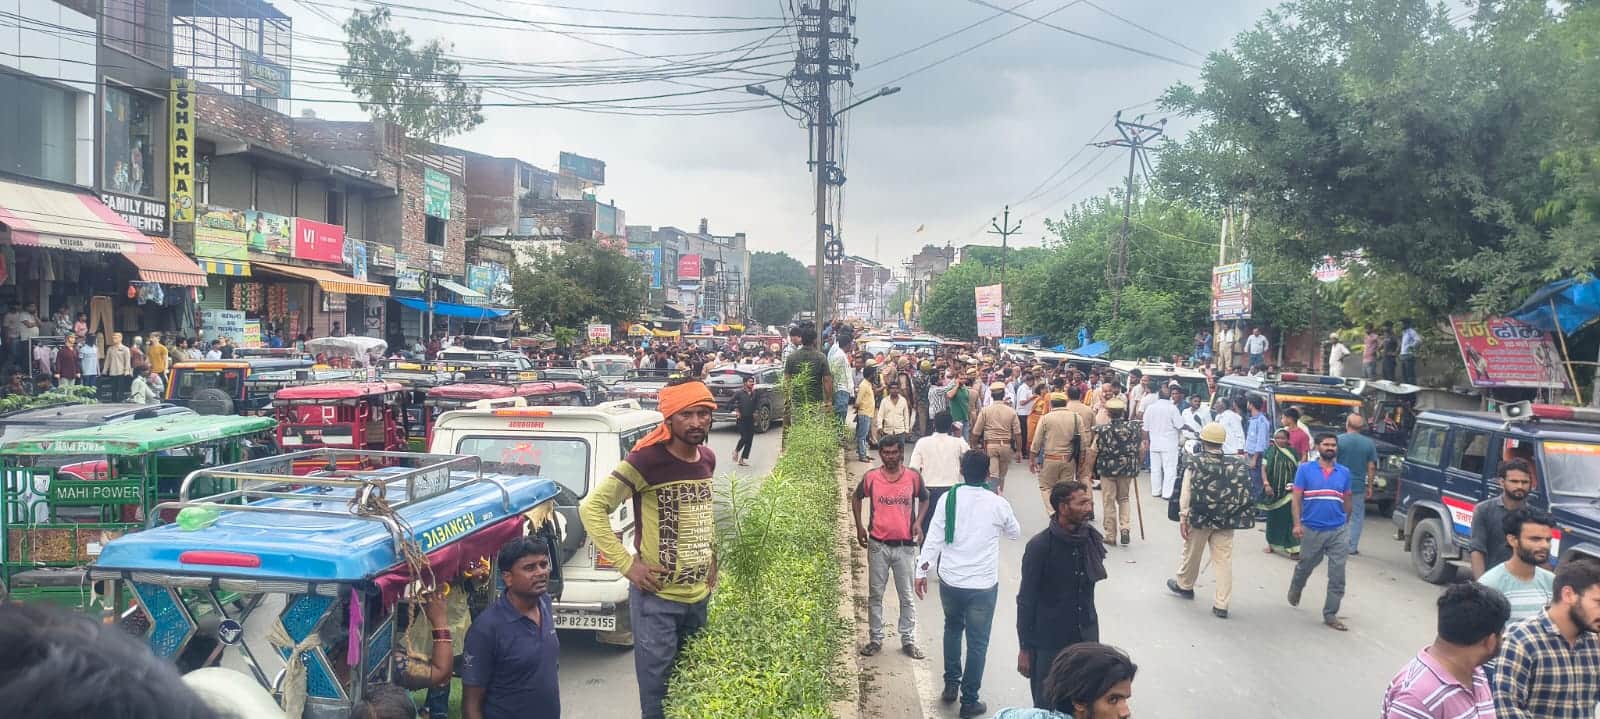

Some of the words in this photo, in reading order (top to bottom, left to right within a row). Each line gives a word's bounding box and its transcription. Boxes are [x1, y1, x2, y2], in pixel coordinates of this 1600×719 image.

[174, 87, 190, 192] SHARMA
[101, 194, 142, 213] FAMILY
[144, 201, 166, 217] HUB
[121, 214, 164, 232] RMENTS
[57, 487, 89, 499] MAHI
[93, 486, 140, 499] POWER
